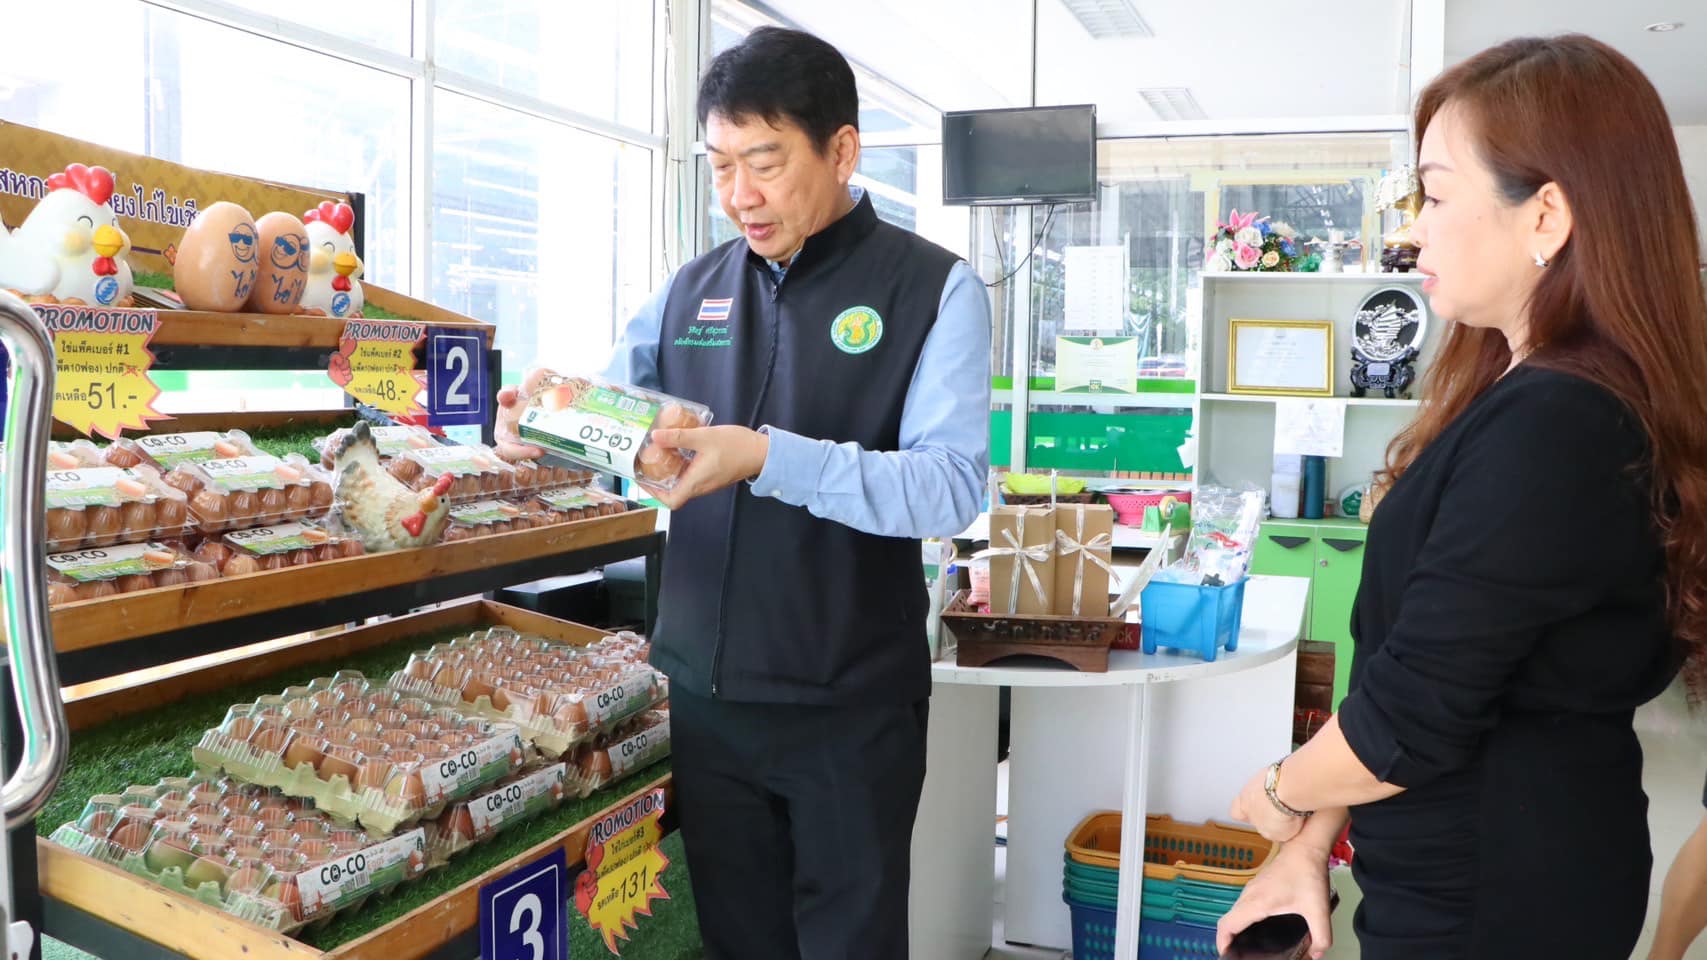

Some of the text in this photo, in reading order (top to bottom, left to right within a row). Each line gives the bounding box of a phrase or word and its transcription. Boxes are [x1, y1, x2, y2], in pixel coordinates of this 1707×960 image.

[0, 169, 200, 227] สหก ยงไก่ไข่เชี
[342, 322, 421, 341] PROMOTION
[445, 346, 470, 405] 2
[88, 382, 137, 410] 51.-
[46, 471, 81, 482] -CO
[597, 686, 624, 708] CO-CO
[621, 734, 648, 757] CO-CO
[440, 750, 477, 778] CO-CO
[486, 784, 522, 812] CO-CO
[320, 853, 366, 886] CO-CO
[509, 893, 544, 960] 3
